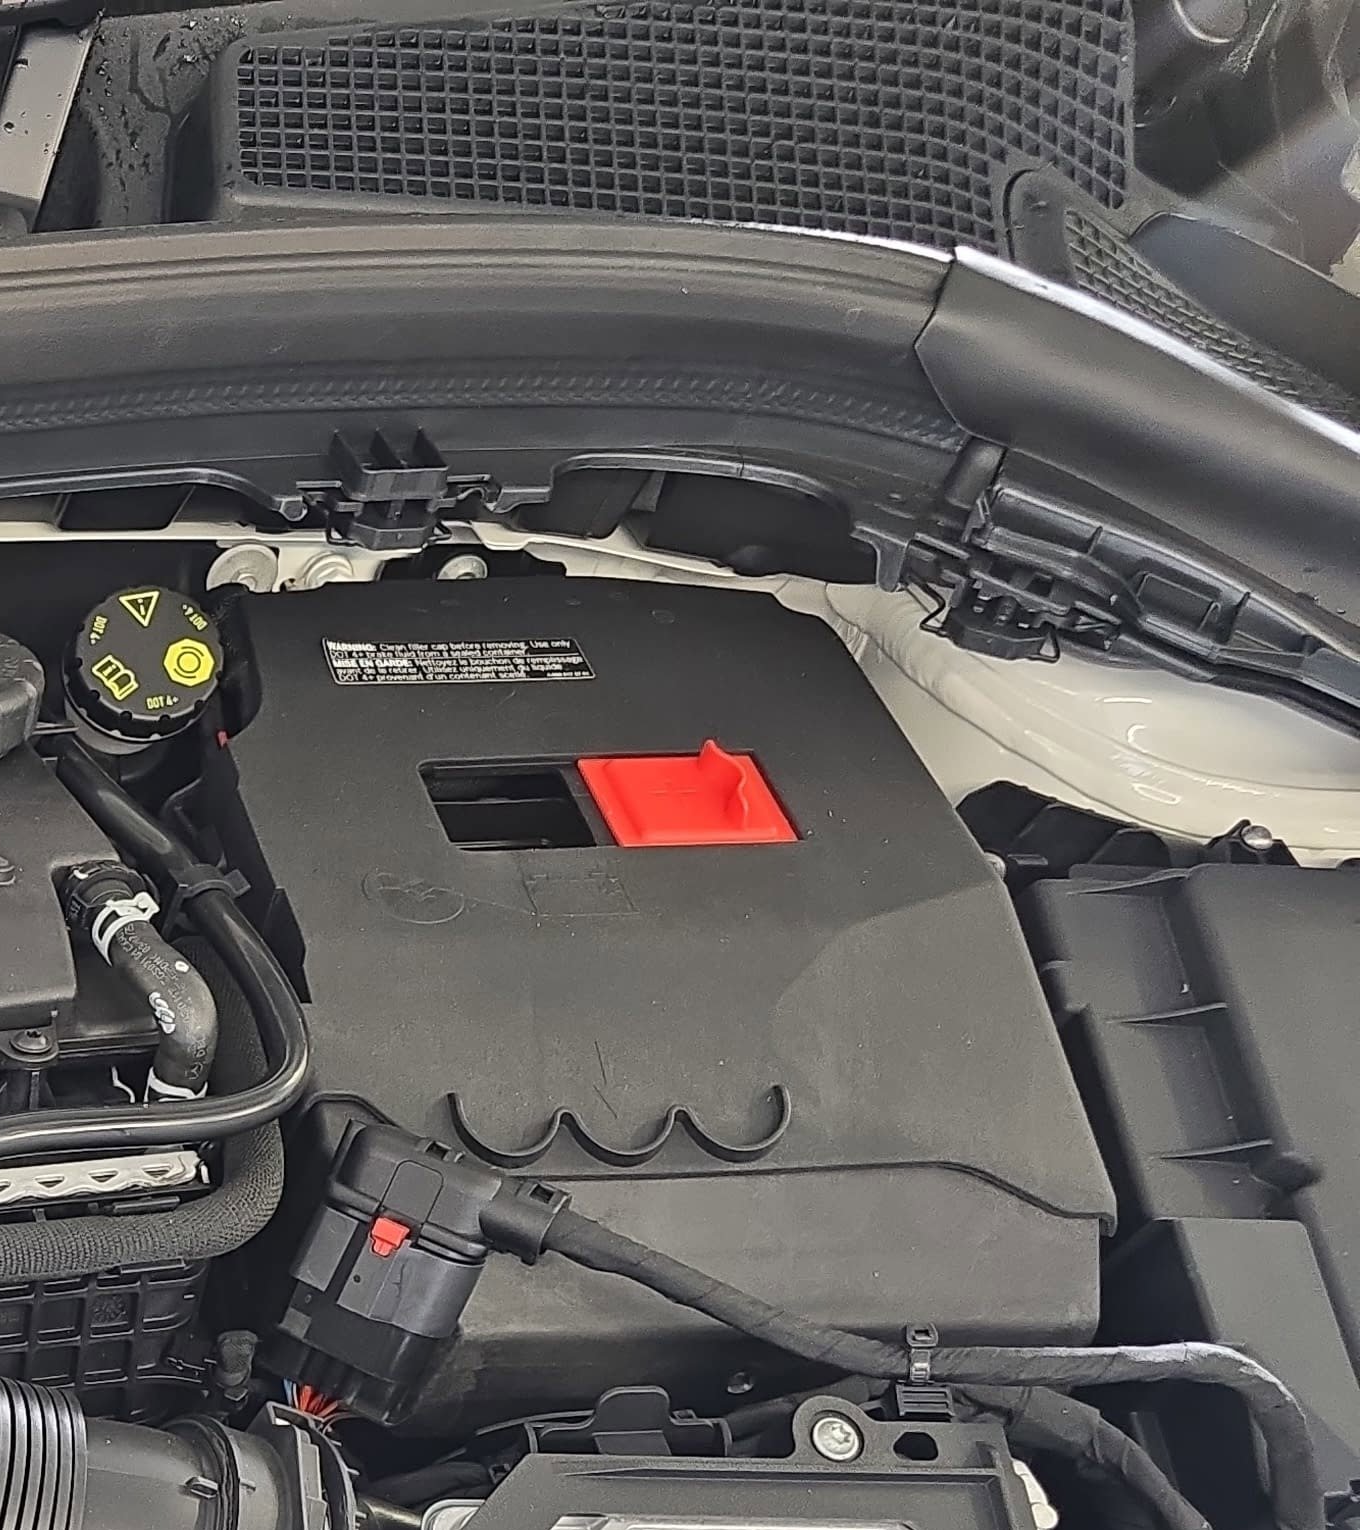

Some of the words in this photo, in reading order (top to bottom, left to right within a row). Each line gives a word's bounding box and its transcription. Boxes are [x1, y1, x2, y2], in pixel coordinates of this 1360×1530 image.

[92, 615, 109, 635] DOT
[188, 613, 209, 632] DOT
[529, 640, 550, 649] Use
[330, 650, 349, 659] DOT
[332, 658, 359, 668] MISE
[359, 658, 375, 667] EN
[512, 657, 526, 665] de
[338, 674, 359, 682] DOT
[146, 695, 166, 710] DOT
